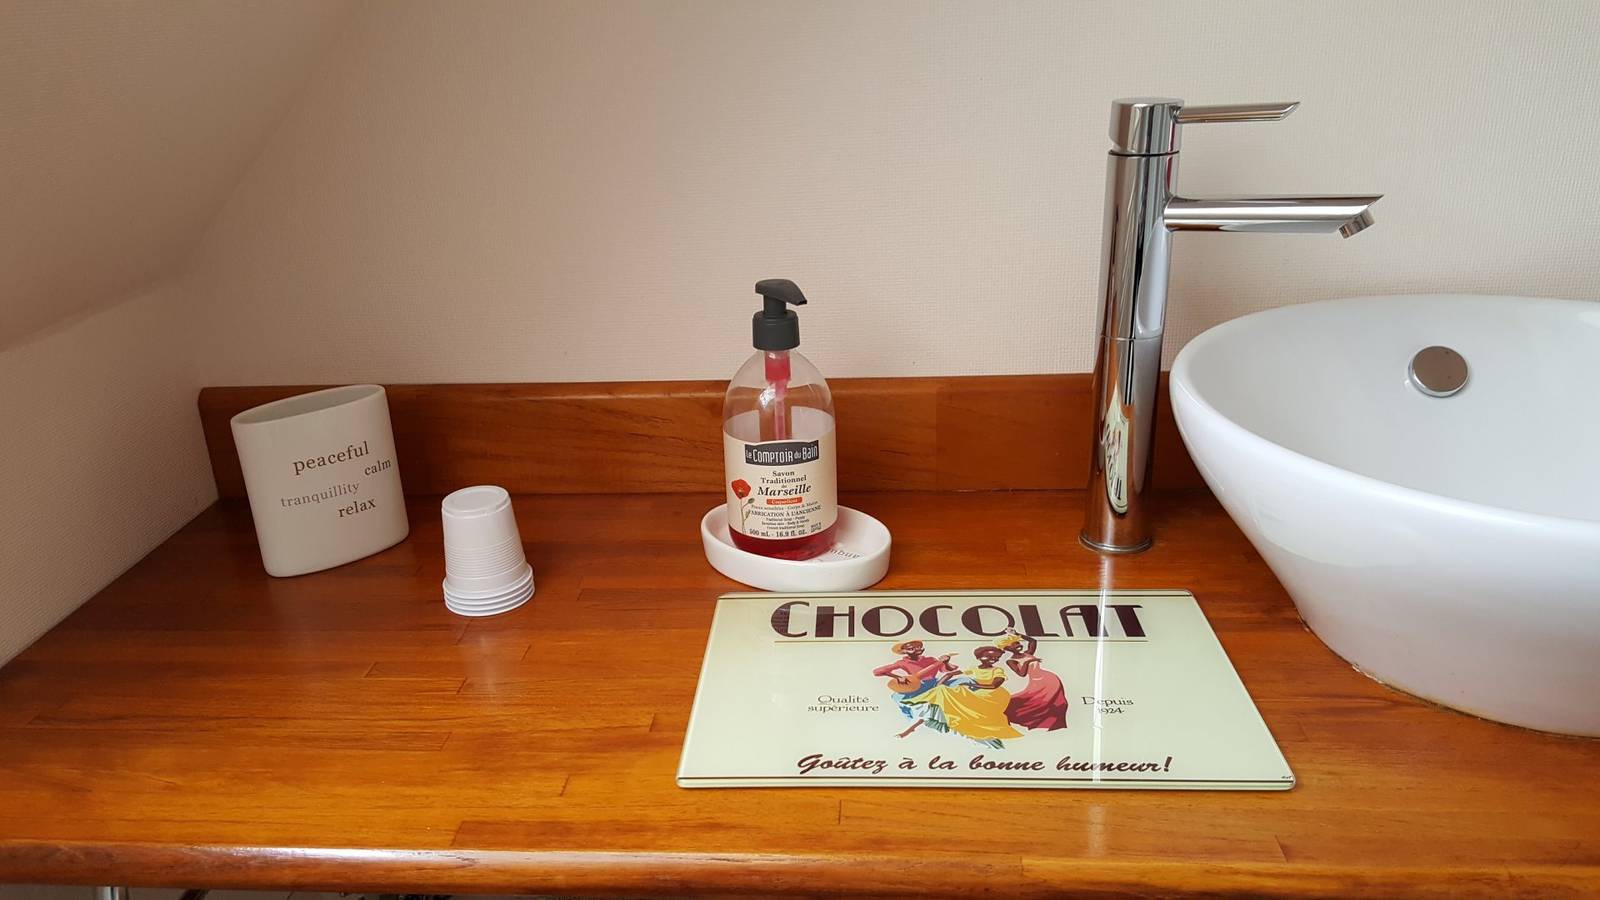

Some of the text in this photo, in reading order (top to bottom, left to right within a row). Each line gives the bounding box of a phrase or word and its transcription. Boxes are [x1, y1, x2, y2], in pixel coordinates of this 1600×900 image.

[293, 440, 369, 475] peaceful
[802, 444, 818, 460] Bain
[364, 459, 392, 475] calm
[760, 474, 807, 484] Traditionnel
[280, 482, 360, 507] tranquillity
[758, 483, 812, 496] Marseille
[337, 498, 377, 517] relax
[749, 528, 760, 536] 500
[771, 600, 1147, 638] CHOCOLAT
[817, 694, 870, 706] Qualité
[1081, 696, 1134, 707] Depuis
[807, 704, 880, 714] supérieure
[797, 753, 1172, 775] Goûtez à la bonne humeur!
